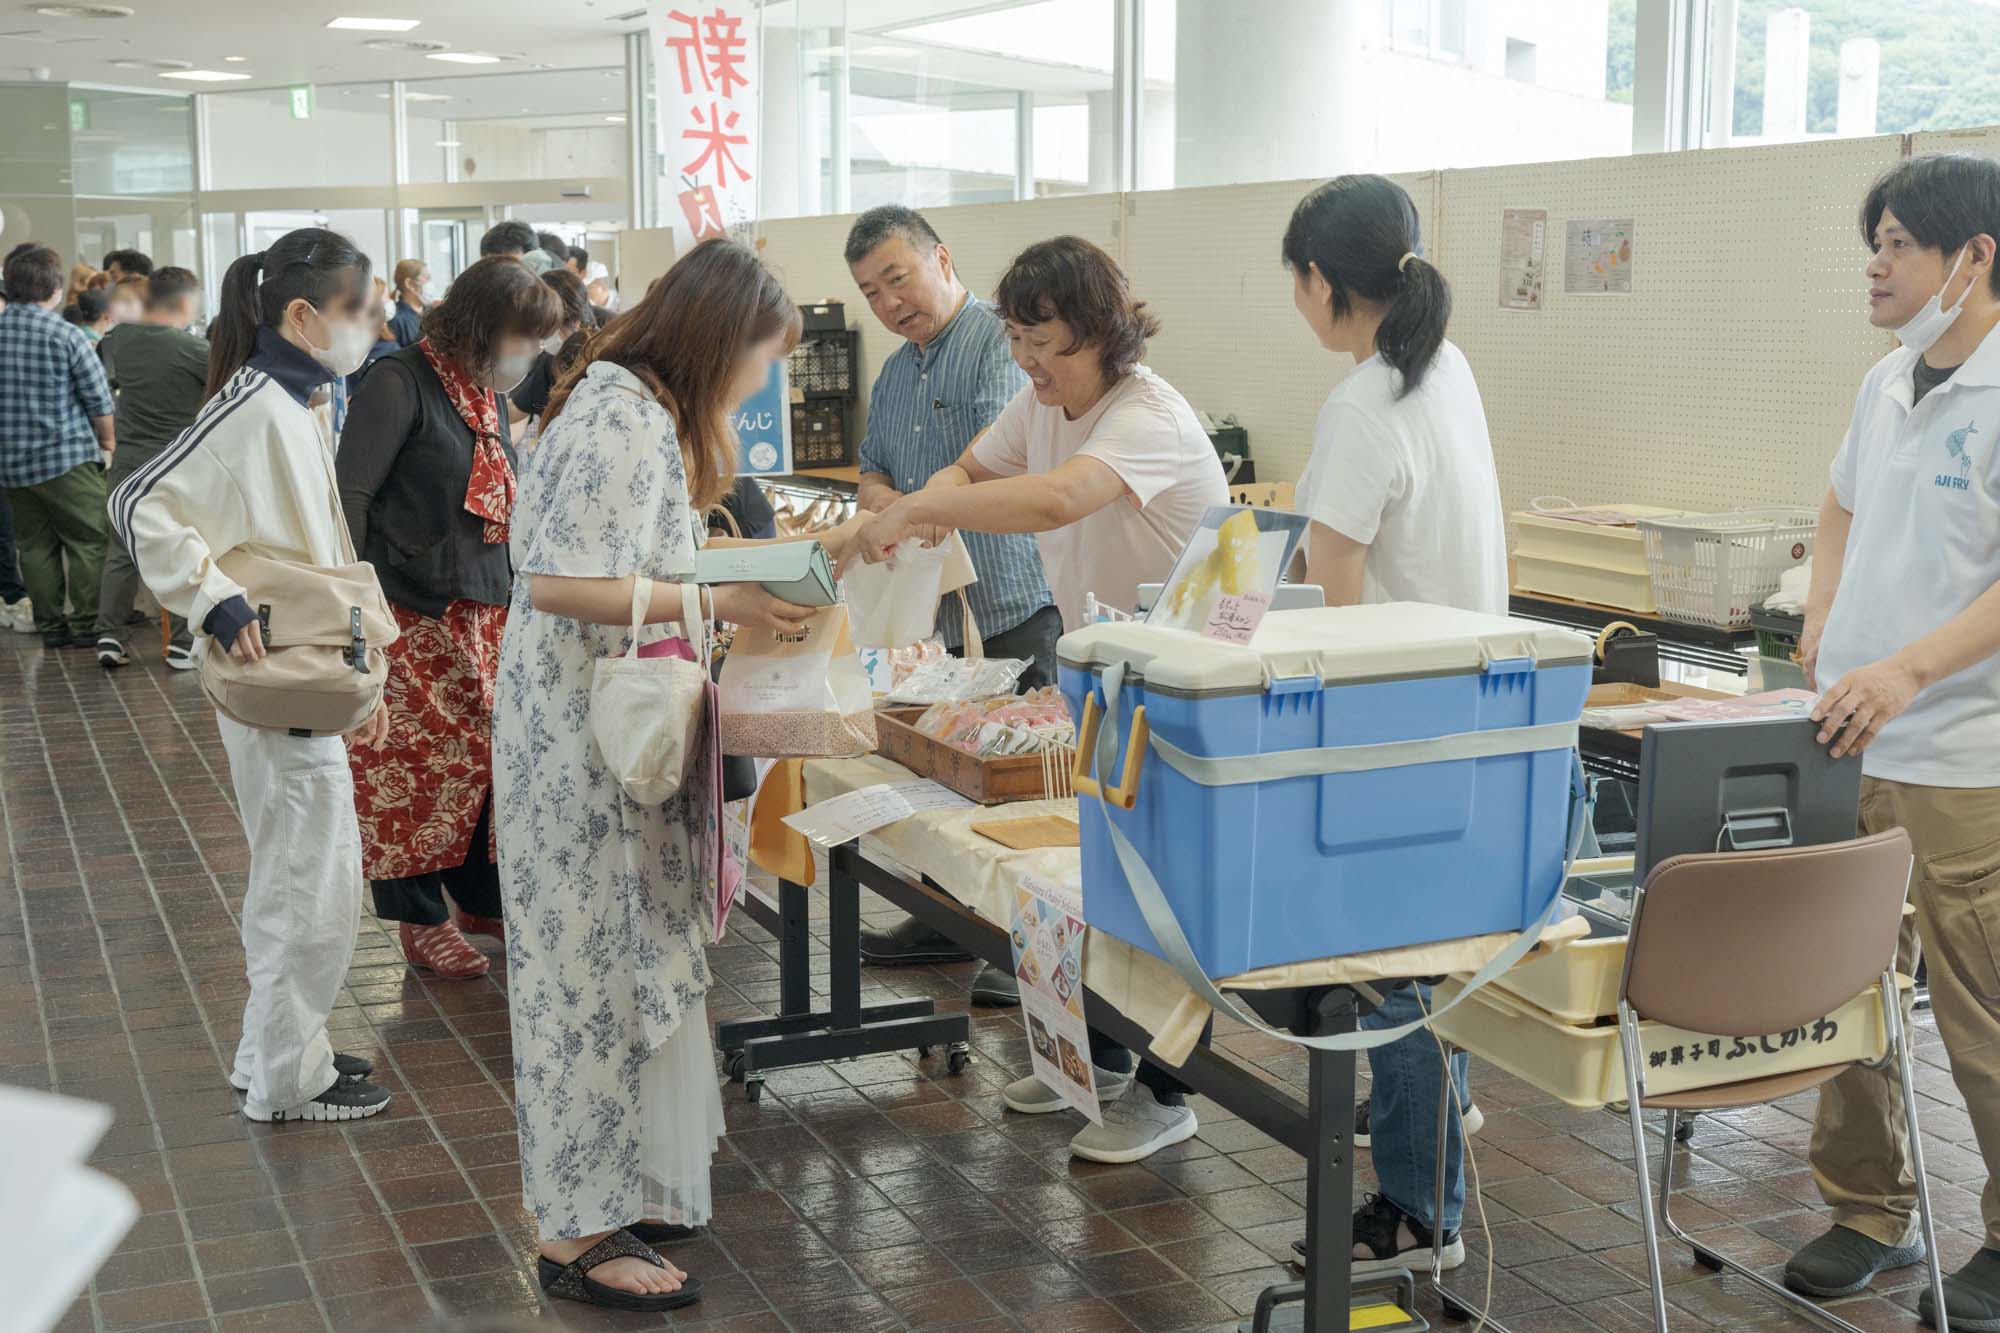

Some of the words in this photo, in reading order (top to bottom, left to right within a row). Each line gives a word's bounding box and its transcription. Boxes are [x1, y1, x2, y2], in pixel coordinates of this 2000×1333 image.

[729, 412, 773, 431] んじ
[1935, 474, 1952, 487] AJI
[1952, 476, 1970, 490] FRY
